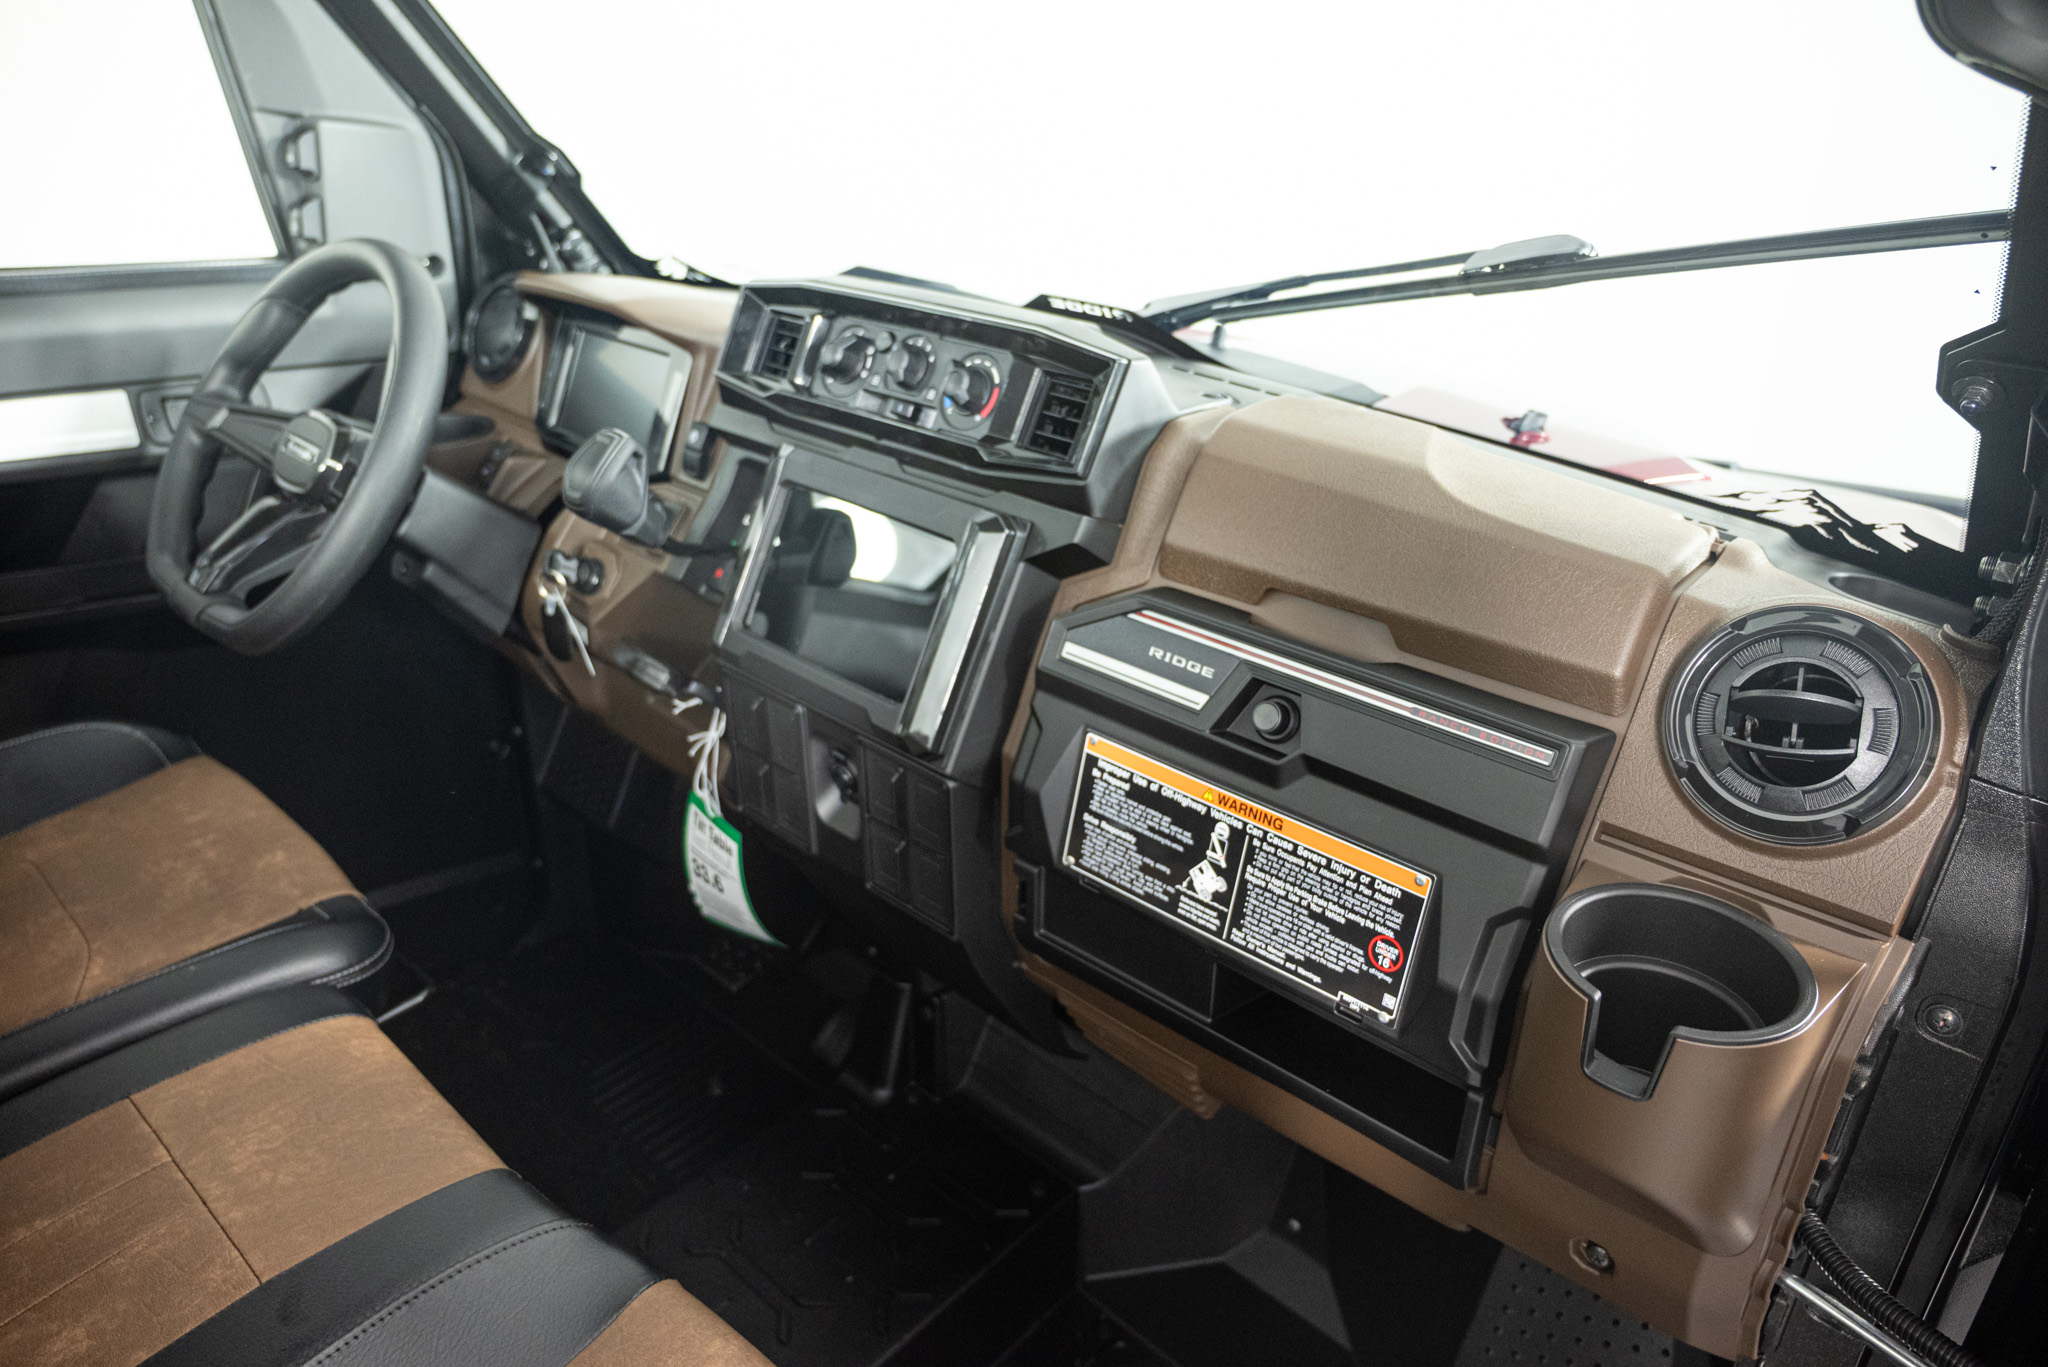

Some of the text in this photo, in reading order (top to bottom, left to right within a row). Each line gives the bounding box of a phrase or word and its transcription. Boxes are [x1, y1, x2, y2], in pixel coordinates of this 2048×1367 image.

[1148, 645, 1215, 679] RIDGE
[1418, 710, 1546, 760] RANCH EDITION
[1096, 758, 1130, 782] Improper
[1132, 773, 1147, 788] Use
[1149, 781, 1158, 793] of
[1160, 785, 1207, 816] Off-Highway
[1209, 807, 1243, 829] Vehicles
[1246, 822, 1263, 838] Can
[1266, 831, 1293, 851] Cause
[1296, 844, 1327, 866] Severe
[1329, 859, 1356, 881] Injury
[1359, 872, 1369, 884] or
[1374, 878, 1403, 899] Death
[1217, 793, 1284, 831] WARNING
[709, 825, 734, 857] Table
[692, 857, 725, 893] 33.6
[1252, 837, 1393, 905] Be Sure Occupants Pay Attention and Plan Ahead
[1243, 871, 1346, 924] Require Proper Use of Your Vehicle
[1375, 946, 1397, 961] UNDER
[1376, 940, 1399, 956] DRIVER
[1377, 954, 1391, 969] 16
